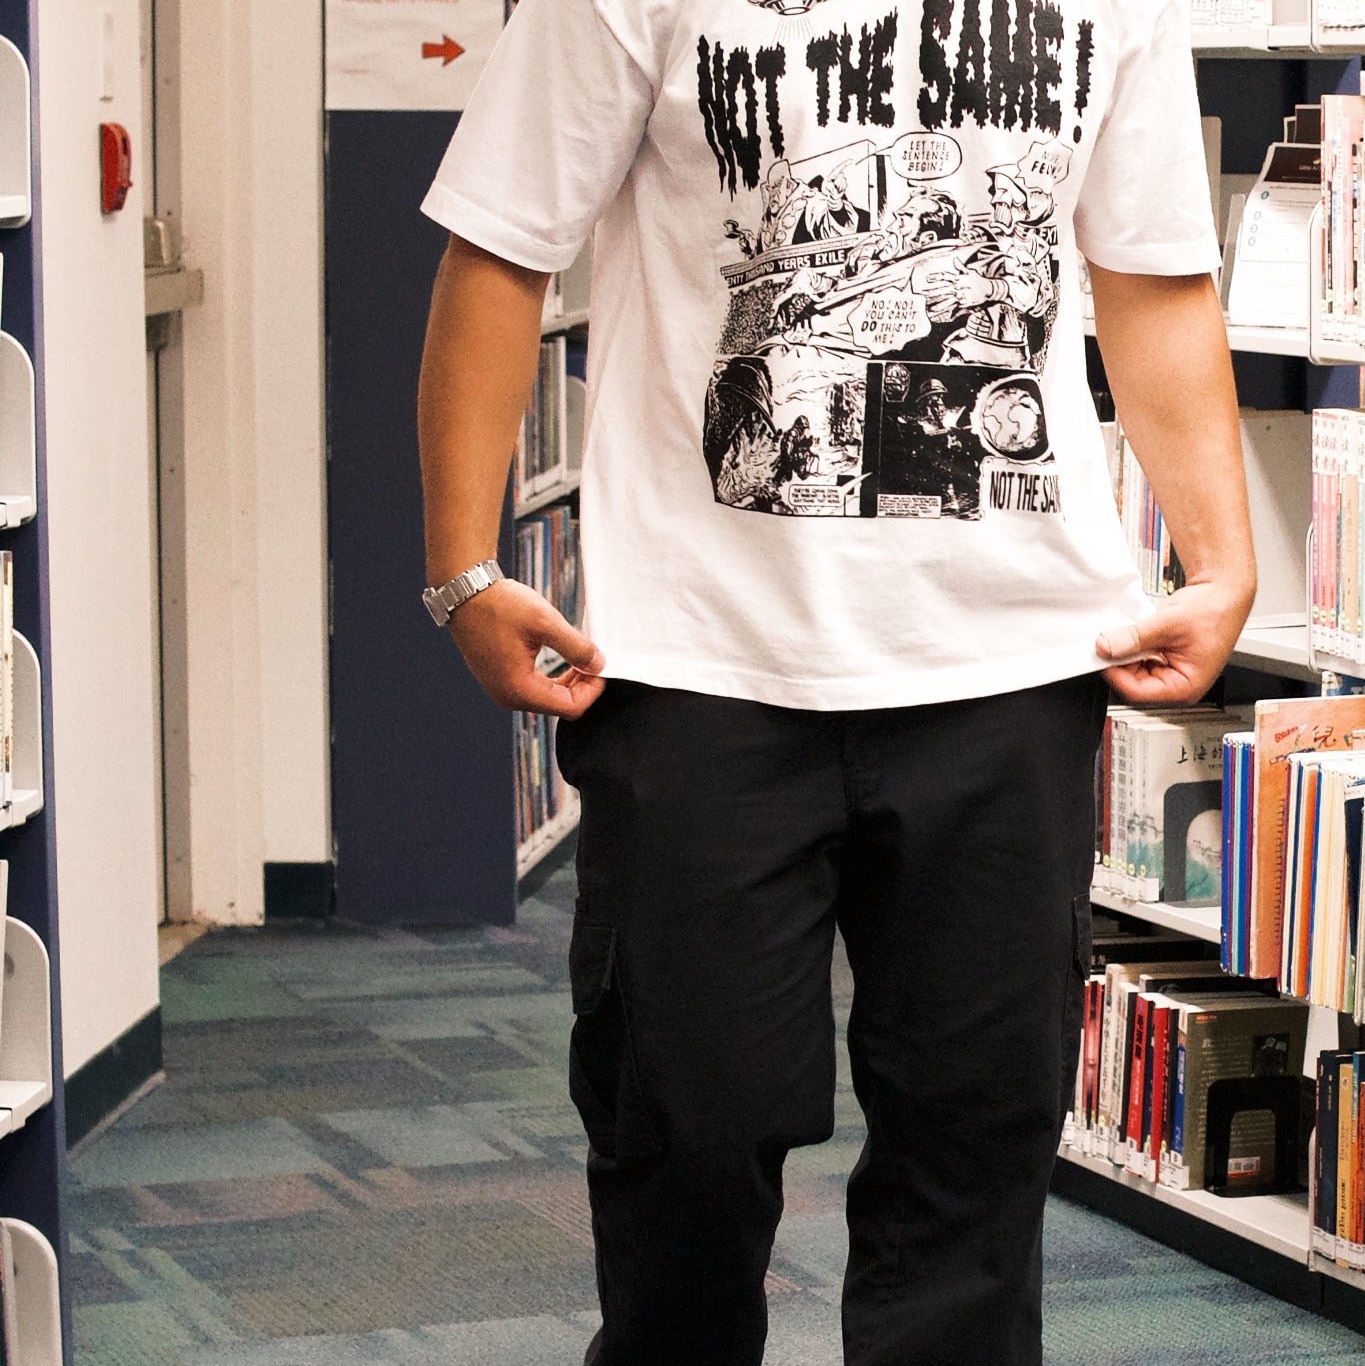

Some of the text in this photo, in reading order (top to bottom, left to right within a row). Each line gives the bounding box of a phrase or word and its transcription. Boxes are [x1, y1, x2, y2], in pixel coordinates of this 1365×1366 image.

[697, 33, 787, 203] NOT
[805, 4, 899, 128] THE
[909, 139, 948, 151] LET THE
[901, 150, 950, 161] SENTENCE
[907, 161, 945, 172] BEGIN!
[777, 250, 845, 271] YEARS EXILE
[861, 320, 917, 334] DO THIS TO
[990, 471, 1039, 513] NOT THE
